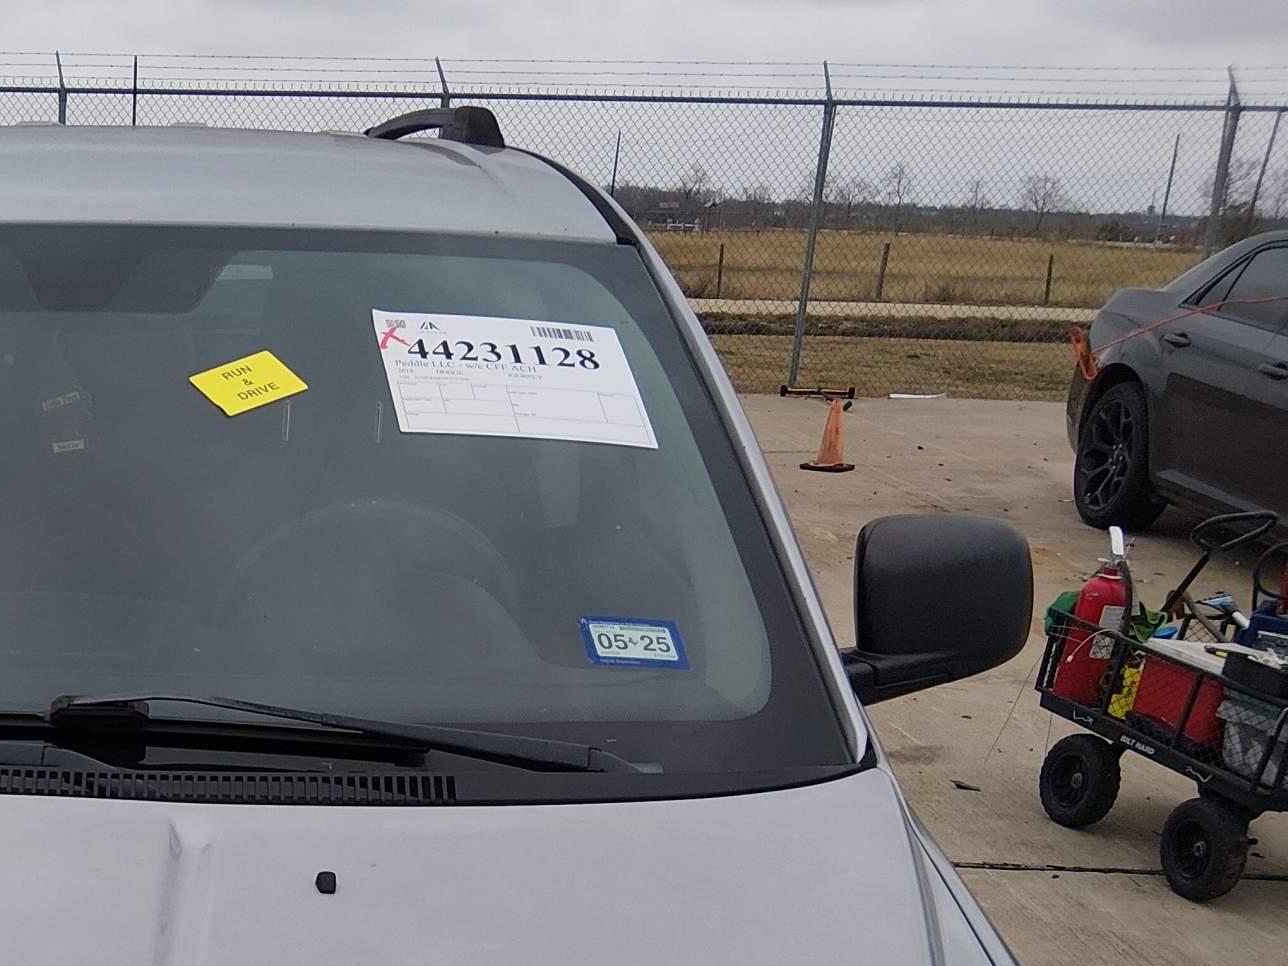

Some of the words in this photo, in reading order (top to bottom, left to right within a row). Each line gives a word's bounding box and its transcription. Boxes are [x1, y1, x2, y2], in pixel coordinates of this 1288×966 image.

[407, 338, 600, 370] 44231128
[395, 359, 429, 368] Peddle
[222, 365, 252, 380] RUN
[242, 378, 255, 386] &
[238, 382, 279, 400] DRIVE
[597, 633, 629, 650] 05
[640, 635, 671, 653] 25
[1135, 742, 1155, 755] HARD
